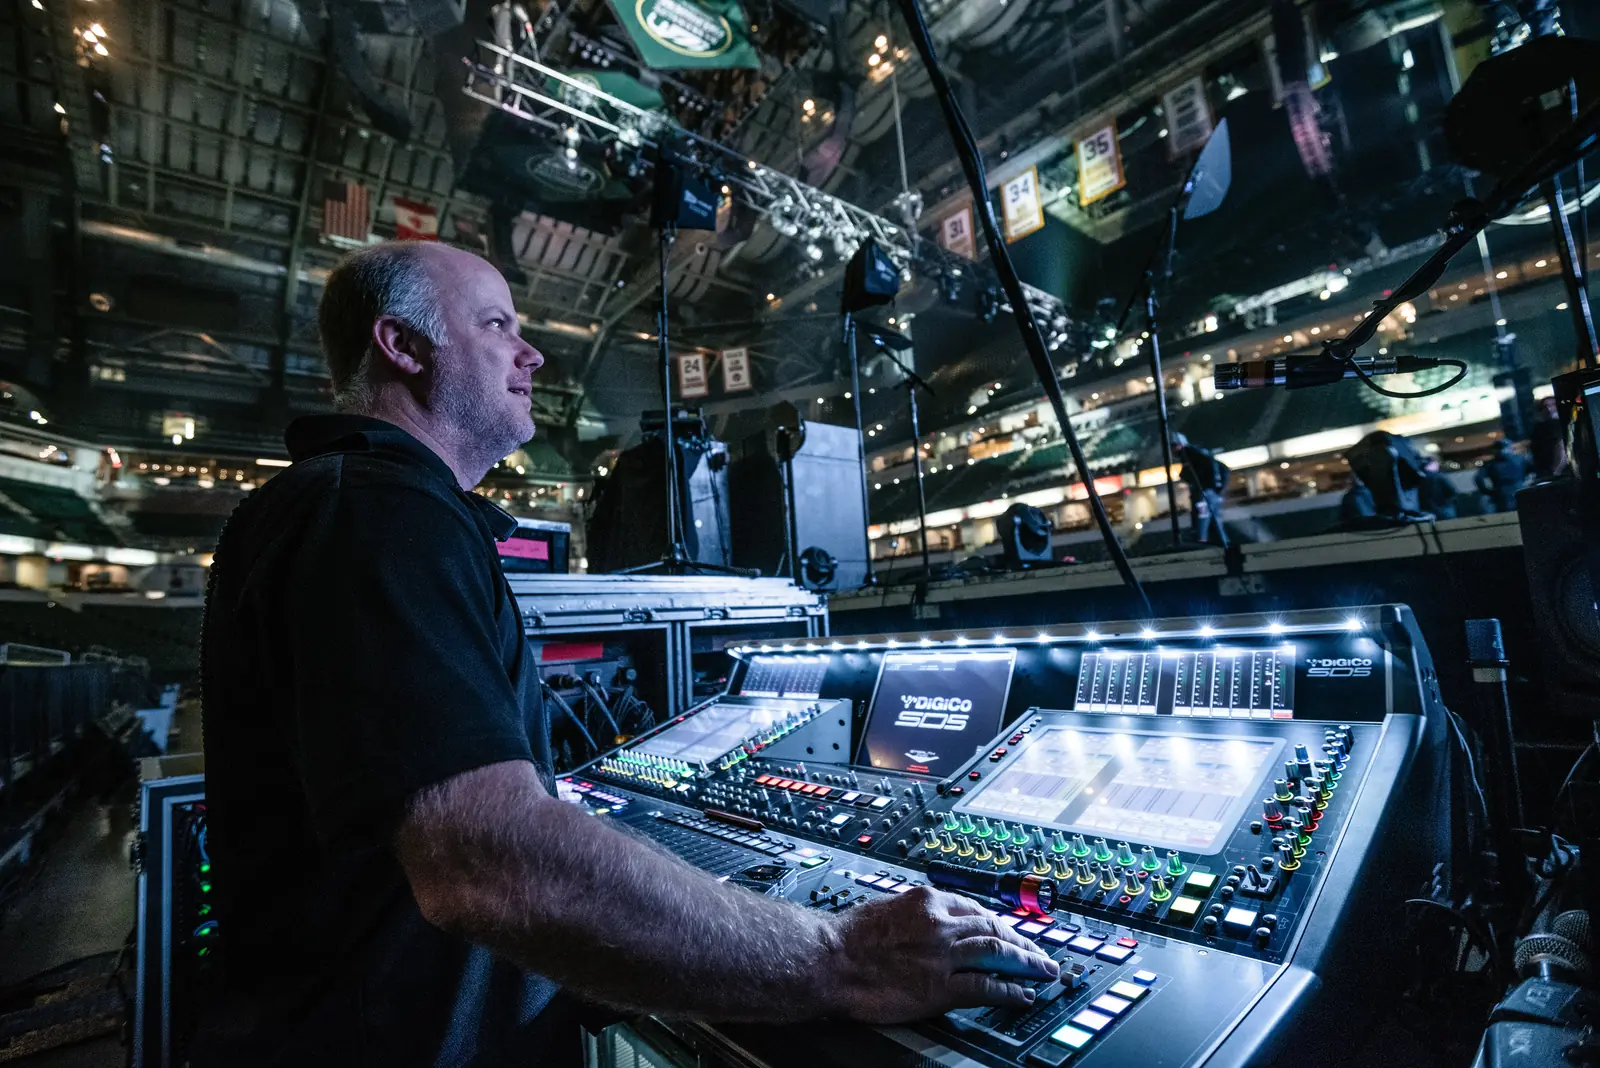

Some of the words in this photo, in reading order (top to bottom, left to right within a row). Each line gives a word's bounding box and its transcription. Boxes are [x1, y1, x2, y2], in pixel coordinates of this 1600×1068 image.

[1084, 133, 1110, 161] 35
[1009, 178, 1031, 204] 34
[949, 220, 964, 239] 31
[684, 358, 701, 374] 24
